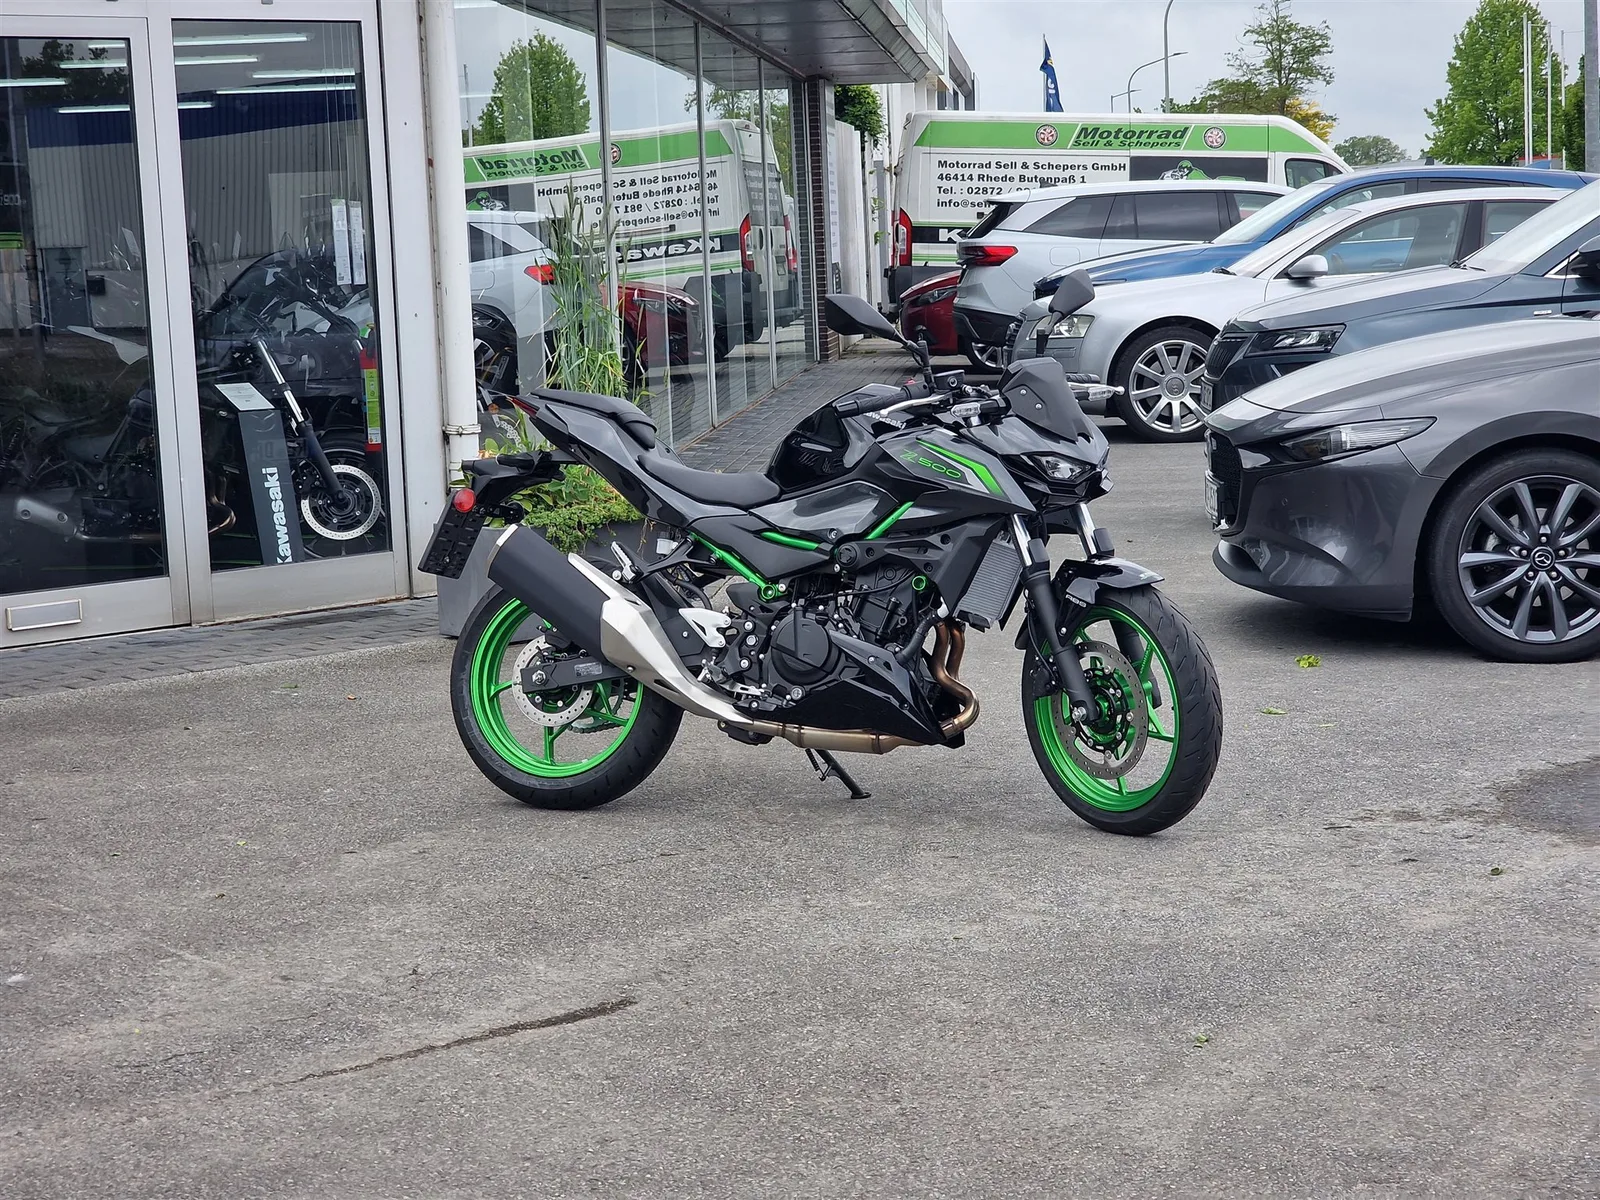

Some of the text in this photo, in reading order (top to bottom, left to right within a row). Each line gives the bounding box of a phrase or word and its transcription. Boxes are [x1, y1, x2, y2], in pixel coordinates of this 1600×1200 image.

[1075, 126, 1190, 141] Motorrad
[1118, 140, 1181, 148] Schepers
[938, 160, 1127, 172] Motorrad Sell & Schepers GmbH
[937, 173, 974, 182] 46414
[977, 174, 1015, 183] Rhede
[1080, 175, 1087, 183] 1
[937, 186, 957, 195] Tel.
[967, 187, 1003, 195] 02872
